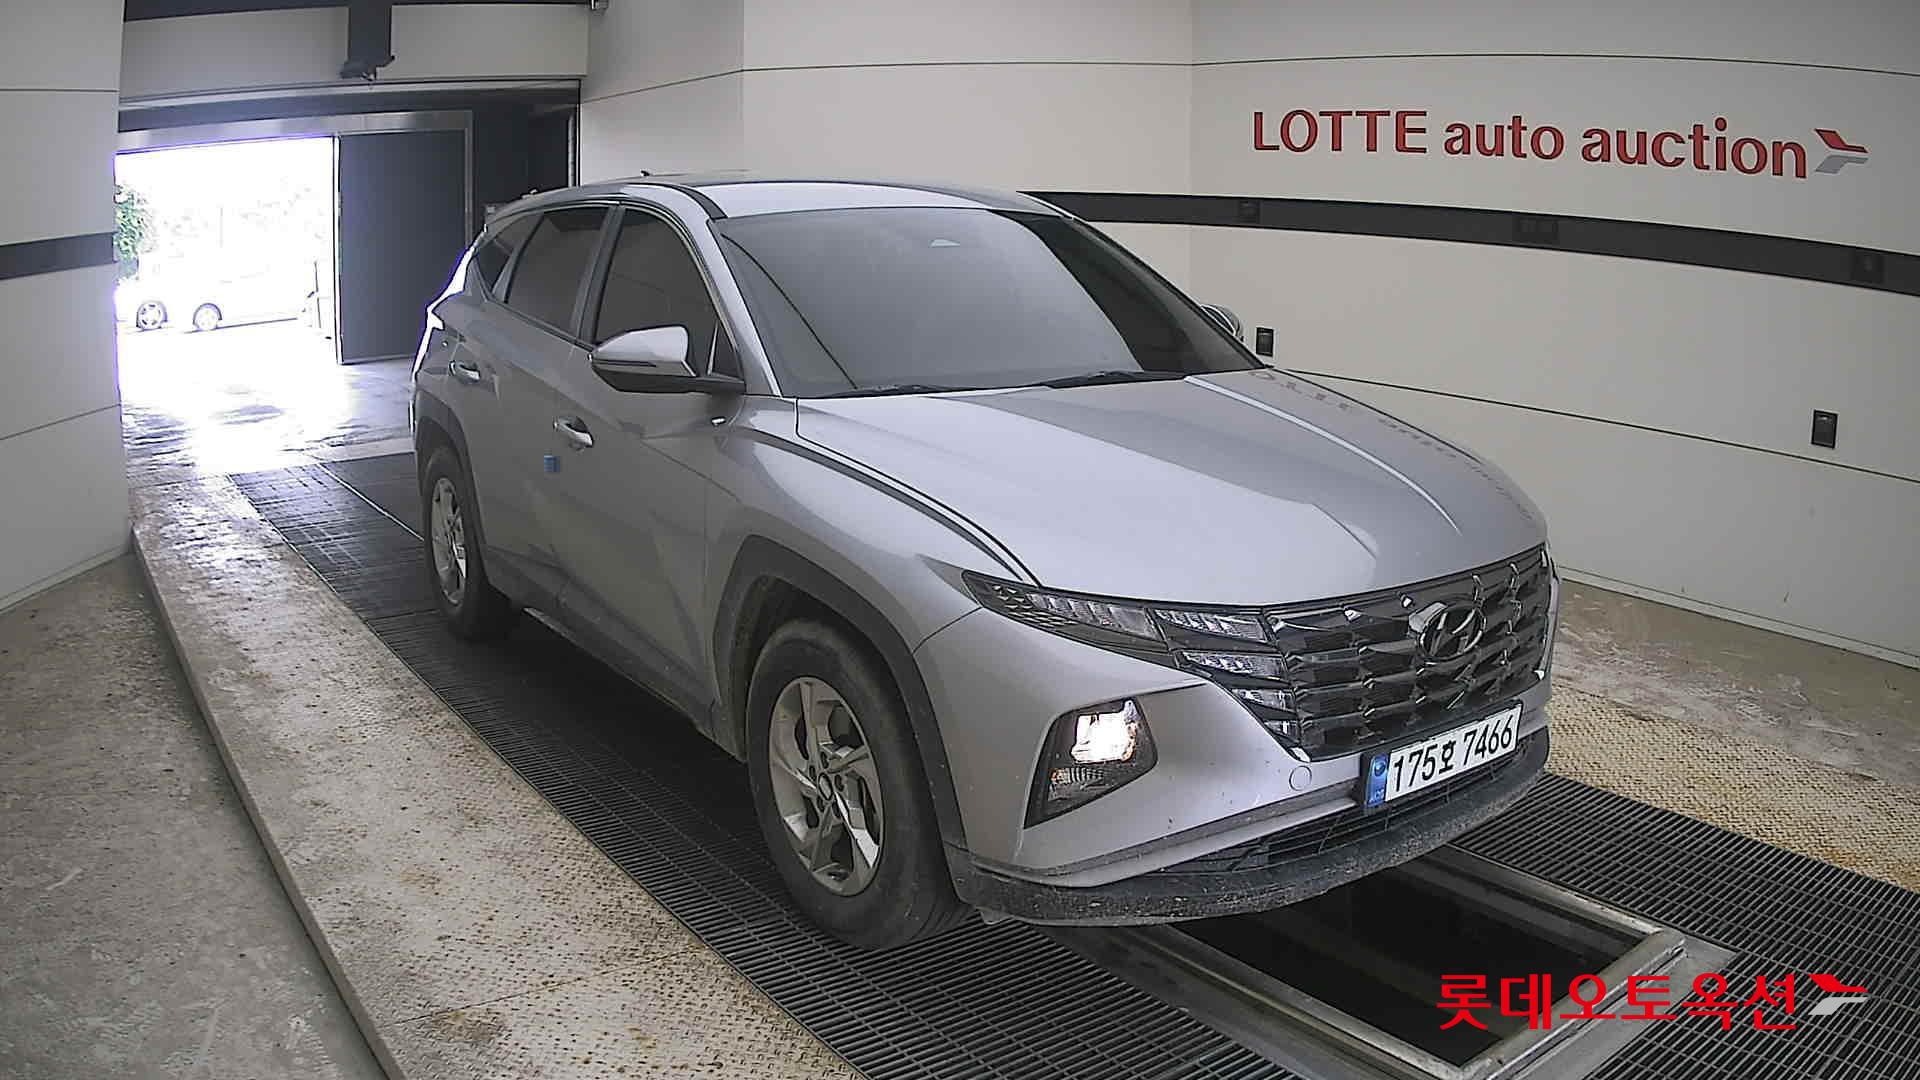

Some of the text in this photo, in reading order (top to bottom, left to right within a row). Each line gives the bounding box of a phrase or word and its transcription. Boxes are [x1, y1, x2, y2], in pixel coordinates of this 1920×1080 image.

[1253, 110, 1807, 178] LOTTE auto auction
[1393, 714, 1514, 793] 175호 7466
